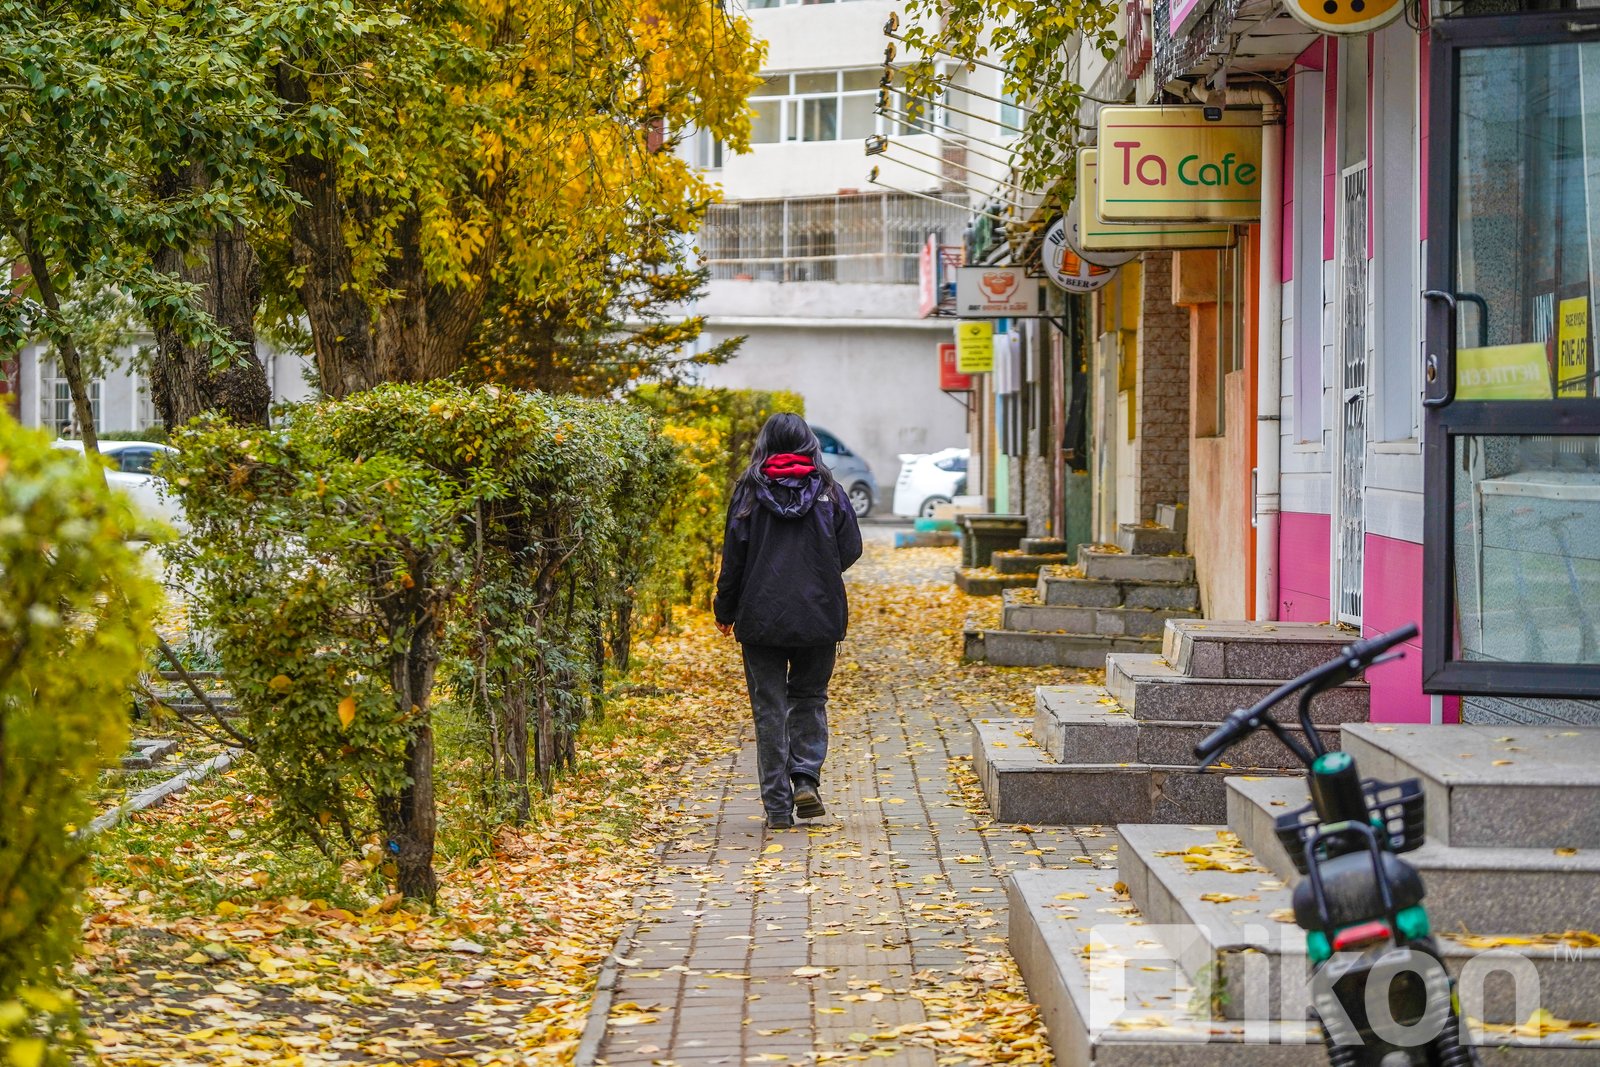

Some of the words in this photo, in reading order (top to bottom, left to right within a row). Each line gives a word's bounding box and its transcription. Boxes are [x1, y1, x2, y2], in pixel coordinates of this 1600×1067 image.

[1113, 141, 1167, 186] Ta
[1177, 152, 1256, 186] Cafe
[1065, 278, 1089, 288] BEER
[1561, 338, 1575, 367] FINE
[1575, 337, 1587, 367] AR
